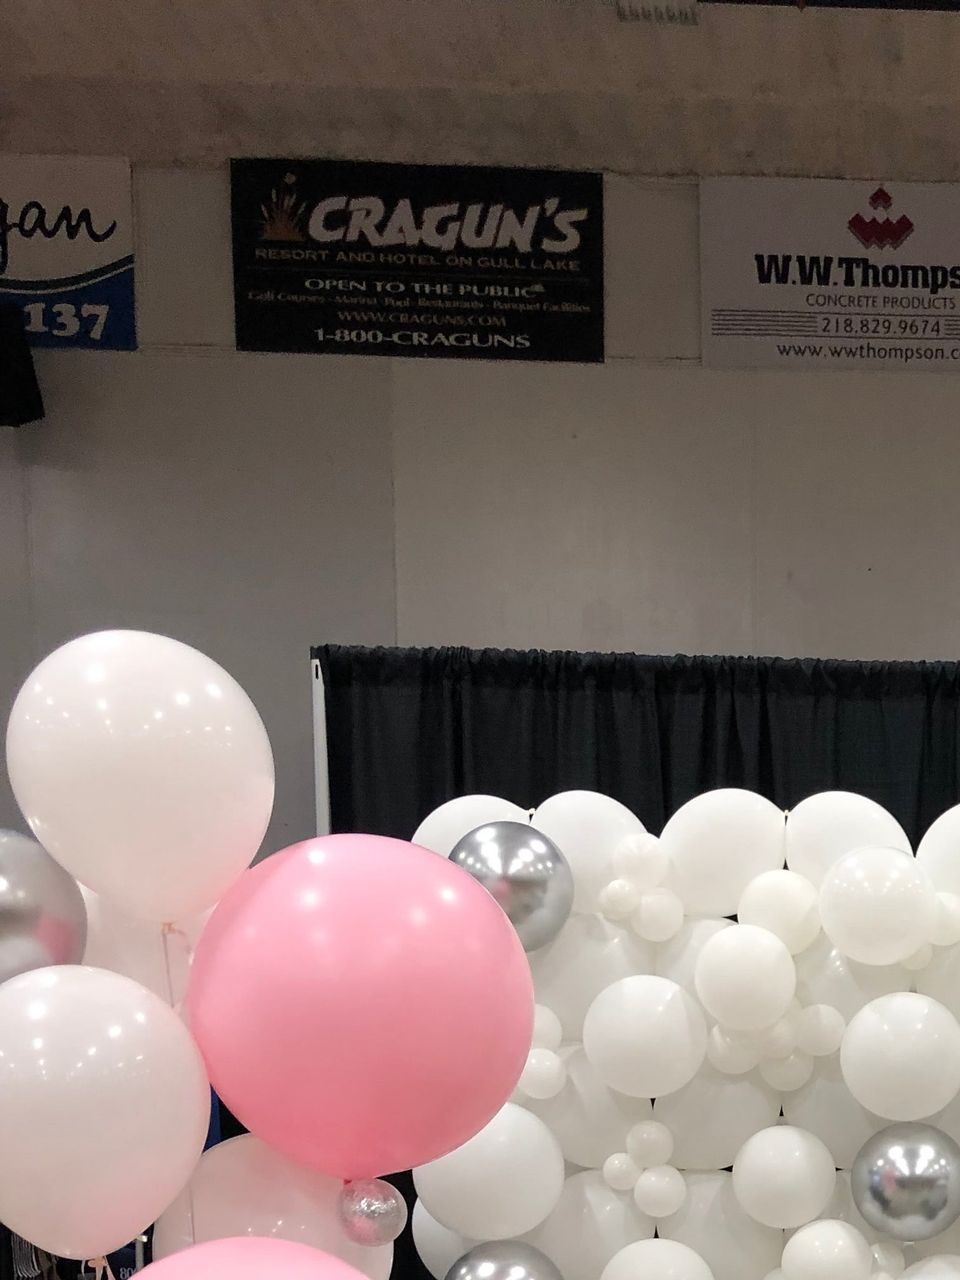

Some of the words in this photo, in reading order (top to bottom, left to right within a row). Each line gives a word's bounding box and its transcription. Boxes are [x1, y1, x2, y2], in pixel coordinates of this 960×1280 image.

[308, 197, 587, 252] CRAGUN'S
[255, 248, 329, 261] RESORT
[336, 250, 375, 263] AND
[379, 252, 440, 266] HOTEL
[446, 255, 472, 267] ON
[477, 256, 527, 270] GULL
[530, 259, 580, 271] LAKE
[304, 278, 366, 291] OPEN
[374, 281, 405, 293] TO
[411, 282, 453, 295] THE
[459, 284, 538, 298] PUBLIC
[806, 293, 877, 309] CONCRETE
[883, 296, 956, 311] PRODUCTS
[821, 317, 941, 336] 218.829.9674
[314, 328, 531, 348] 1-800-CRAGUNS
